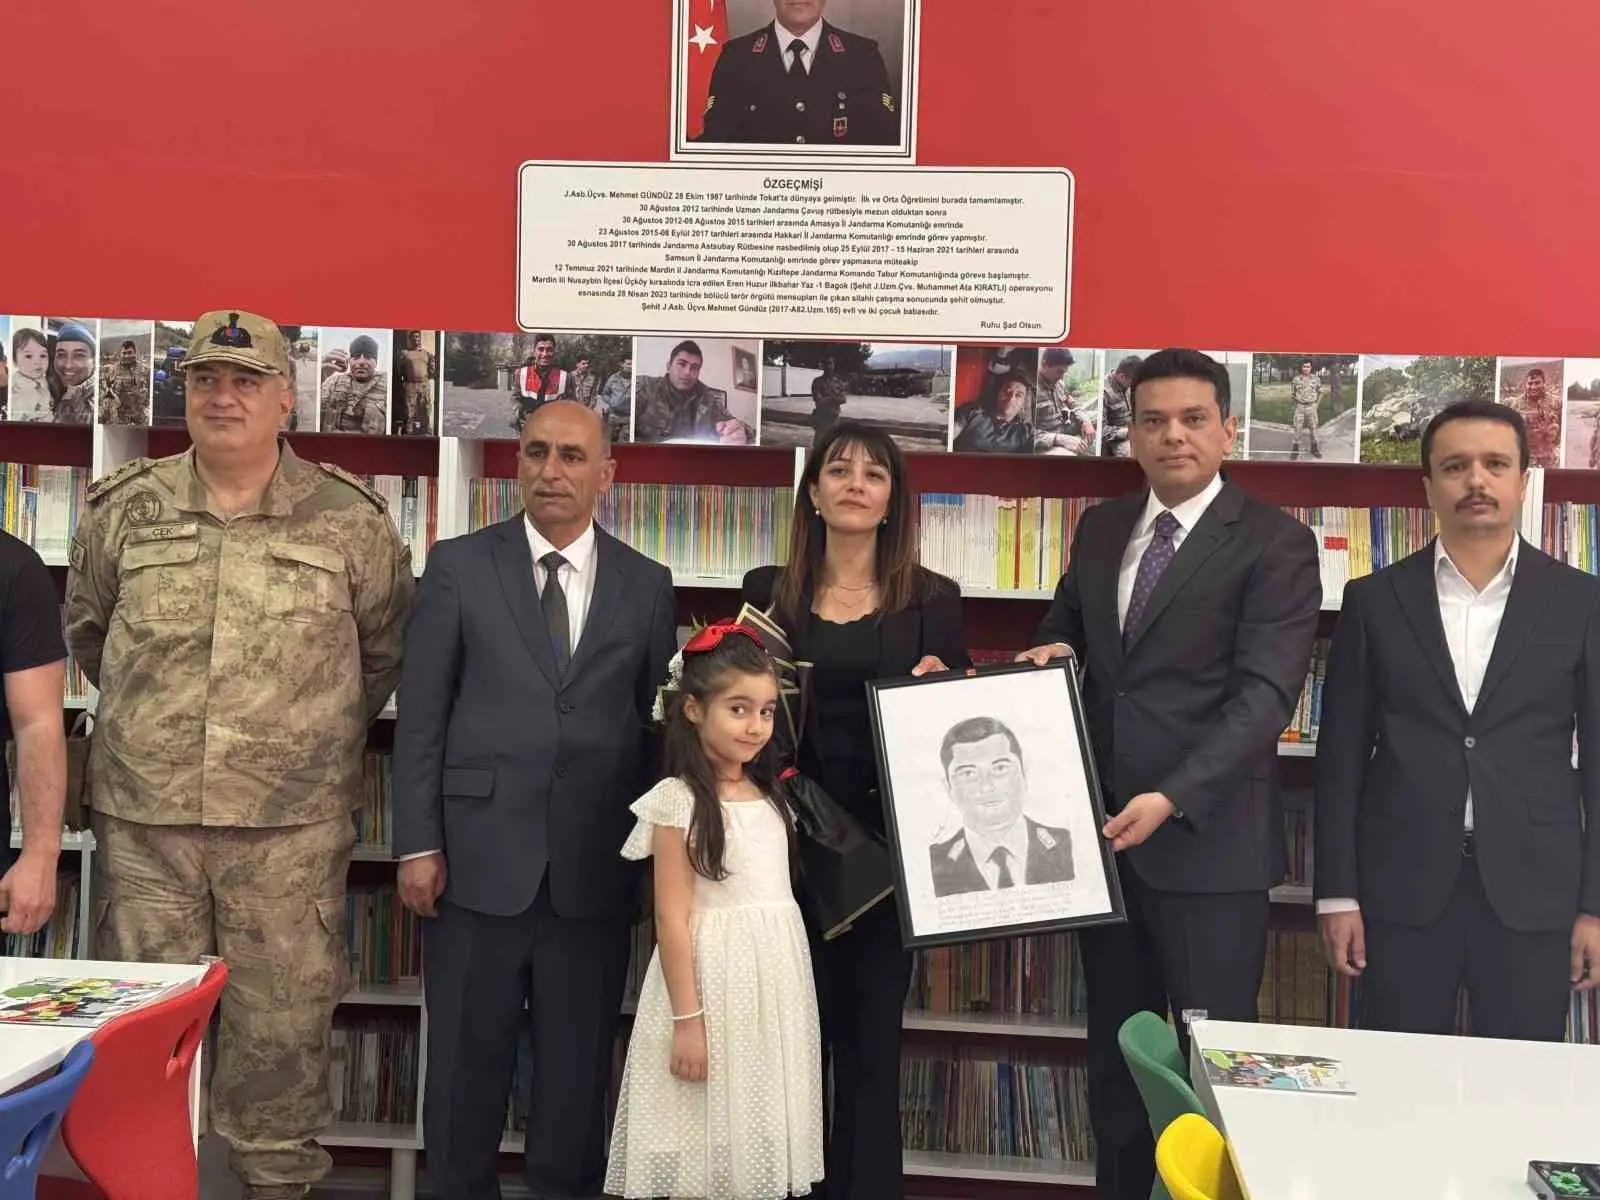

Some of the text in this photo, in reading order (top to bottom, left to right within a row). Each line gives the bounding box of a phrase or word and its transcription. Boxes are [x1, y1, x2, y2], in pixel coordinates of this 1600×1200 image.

[763, 178, 823, 190] ÖZGEÇMİŞİ
[609, 191, 638, 199] Mehmet
[640, 190, 673, 200] GÜNDÜZ
[706, 192, 723, 201] 1987
[725, 192, 757, 201] tarihinde
[759, 194, 788, 202] Tokat'ta
[790, 194, 821, 204] dünyaya
[861, 193, 870, 204] İlk
[882, 196, 899, 204] Orta
[901, 194, 939, 205] Öğretimini
[942, 196, 967, 205] burada
[969, 196, 1024, 206] tamamlamıştır.
[649, 204, 680, 214] Ağustos
[682, 204, 699, 212] 2012
[701, 205, 733, 213] tarihinde
[736, 206, 761, 214] Uzman
[763, 207, 799, 215] Jandarma
[801, 206, 824, 216] Çavuş
[826, 208, 862, 217] rütbesiyle
[891, 208, 923, 216] olduktan
[925, 208, 947, 216] sonra
[622, 215, 631, 223] 30
[632, 217, 663, 226] Ağustos
[695, 217, 725, 227] Ağustos
[728, 218, 745, 226] 2015
[746, 218, 775, 227] tarihleri
[777, 219, 808, 227] arasında
[810, 220, 840, 229] Amasya
[842, 219, 846, 228] İl
[848, 220, 884, 228] Jandarma
[887, 221, 931, 230] Komutanlığı
[933, 222, 963, 230] emrinde
[599, 228, 607, 236] 23
[609, 228, 639, 237] Ağustos
[671, 229, 690, 239] Eylül
[691, 230, 709, 238] 2017
[711, 230, 739, 238] tarihleri
[775, 232, 802, 241] Hakkari
[804, 229, 808, 239] İl
[810, 232, 847, 240] Jandarma
[849, 232, 893, 242] Komutanlığı
[896, 233, 925, 241] emrinde
[928, 234, 948, 243] görev
[577, 240, 608, 249] Ağustos
[610, 240, 626, 248] 2017
[629, 241, 661, 249] tarihinde
[663, 241, 699, 249] Jandarma
[700, 242, 735, 252] Astsubay
[737, 242, 774, 251] Rütbesine
[776, 243, 820, 253] nasbedilmiş
[823, 244, 839, 254] olup
[841, 244, 849, 253] 25
[851, 244, 870, 254] Eylül
[897, 245, 904, 253] 15
[907, 245, 934, 256] Haziran
[936, 246, 953, 254] 2021
[956, 246, 984, 254] tarihleri
[987, 247, 1019, 255] arasında
[665, 253, 695, 262] Samsun
[703, 255, 739, 263] Jandarma
[742, 255, 786, 265] Komutanlığı
[788, 256, 817, 264] emrinde
[820, 257, 840, 266] görev
[884, 258, 918, 266] müteakip
[555, 263, 563, 272] 12
[565, 264, 595, 273] Temmuz
[597, 265, 613, 273] 2021
[616, 265, 648, 273] tarihinde
[650, 266, 675, 274] Mardin
[683, 266, 719, 275] Jandarma
[722, 267, 765, 277] Komutanlığı
[768, 268, 799, 278] Kızıltepe
[801, 268, 837, 277] Jandarma
[840, 269, 875, 277] Komando
[877, 270, 898, 279] Tabur
[900, 270, 958, 281] Komutanlığında
[960, 272, 986, 281] göreve
[988, 272, 1031, 281] başlamıştır.
[532, 276, 557, 284] Mardin
[568, 277, 601, 286] Nusaybin
[604, 275, 623, 286] İlçesi
[625, 277, 647, 288] Üçköy
[650, 278, 685, 286] kırsalında
[727, 279, 744, 287] Eren
[917, 282, 958, 291] Muhammet
[959, 283, 972, 292] Ata
[1008, 285, 1053, 294] operasyonu
[578, 289, 615, 297] esnasında
[651, 290, 667, 298] 2023
[670, 290, 702, 298] tarihinde
[731, 292, 748, 300] terör
[751, 293, 775, 303] örgütü
[777, 294, 817, 302] mensupları
[830, 294, 850, 303] çıkan
[852, 294, 874, 302] silahlı
[875, 296, 904, 304] çatışma
[907, 295, 948, 303] sonucunda
[950, 296, 969, 305] şehit
[970, 294, 1005, 305] olmuştur.
[642, 303, 660, 312] Şehit
[738, 304, 767, 312] Gündüz
[843, 307, 855, 315] evli
[879, 308, 901, 317] çocuk
[903, 307, 940, 315] babasıdır.
[981, 320, 1000, 328] Ruhu
[1003, 321, 1017, 331] Şad
